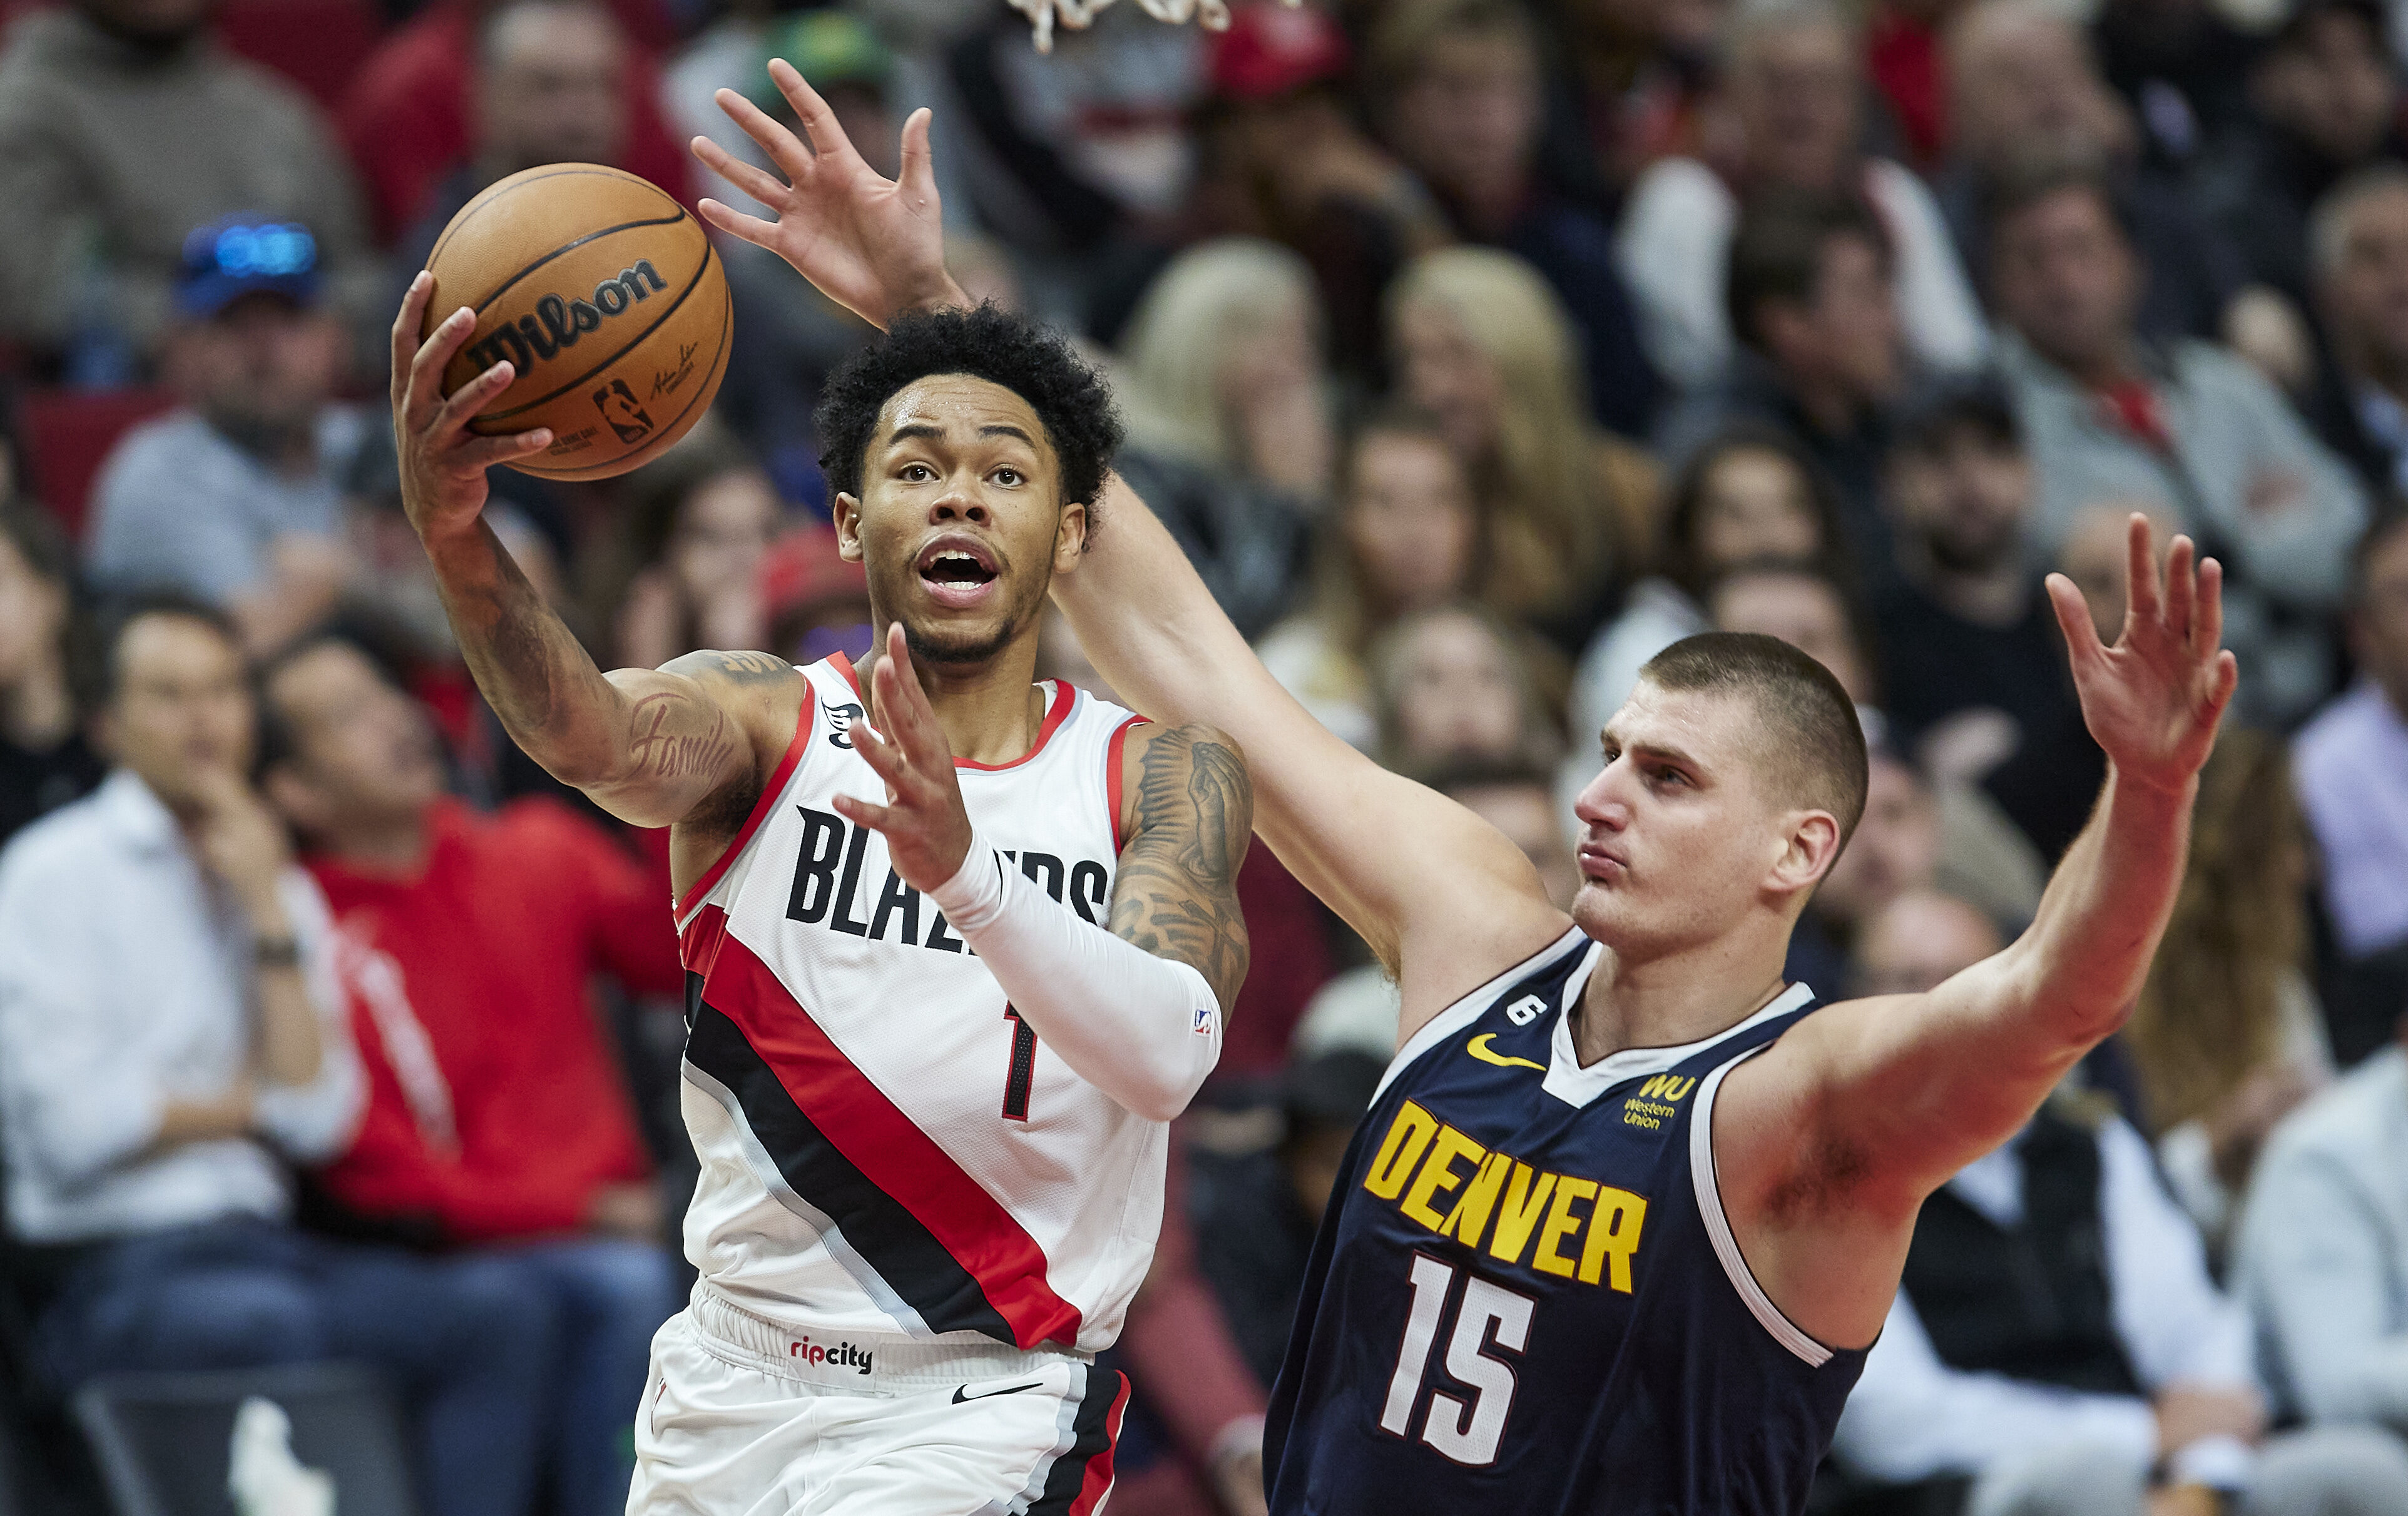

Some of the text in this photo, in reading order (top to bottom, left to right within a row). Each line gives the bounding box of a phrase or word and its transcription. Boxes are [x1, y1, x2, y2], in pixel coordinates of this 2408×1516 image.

[466, 258, 668, 379] Wilson
[626, 692, 733, 790] Family
[1506, 994, 1548, 1026] 6
[1002, 999, 1038, 1123] 1
[1624, 1099, 1675, 1118] Western
[1638, 1074, 1696, 1102] WU
[1623, 1111, 1660, 1131] Union
[1363, 1097, 1650, 1295] DENVER
[1378, 1249, 1538, 1467] 15
